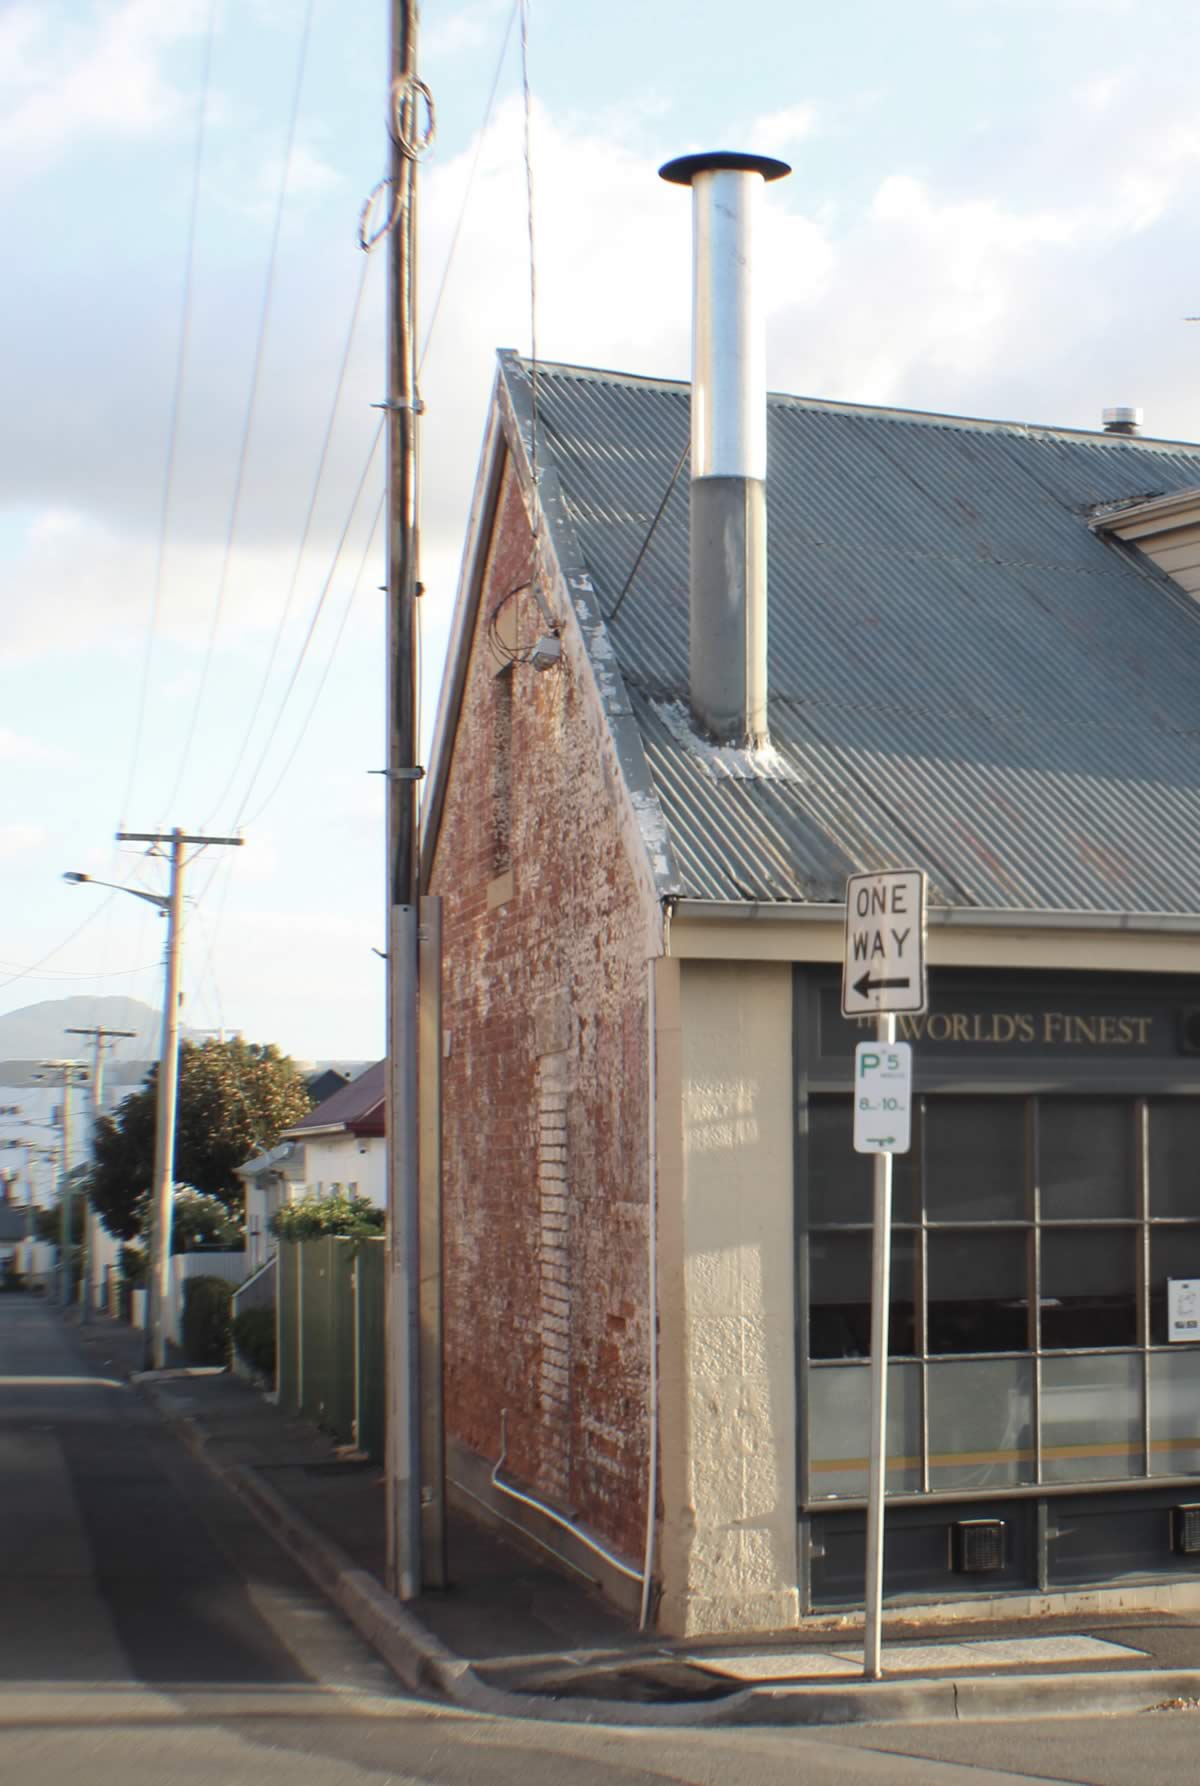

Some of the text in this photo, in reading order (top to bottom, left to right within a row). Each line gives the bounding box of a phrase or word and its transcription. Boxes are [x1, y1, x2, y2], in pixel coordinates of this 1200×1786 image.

[856, 884, 907, 917] ONE
[852, 927, 911, 961] WAY
[900, 1012, 1035, 1042] WORLD'S
[1043, 1012, 1153, 1044] FINEST
[860, 1053, 900, 1079] P 5
